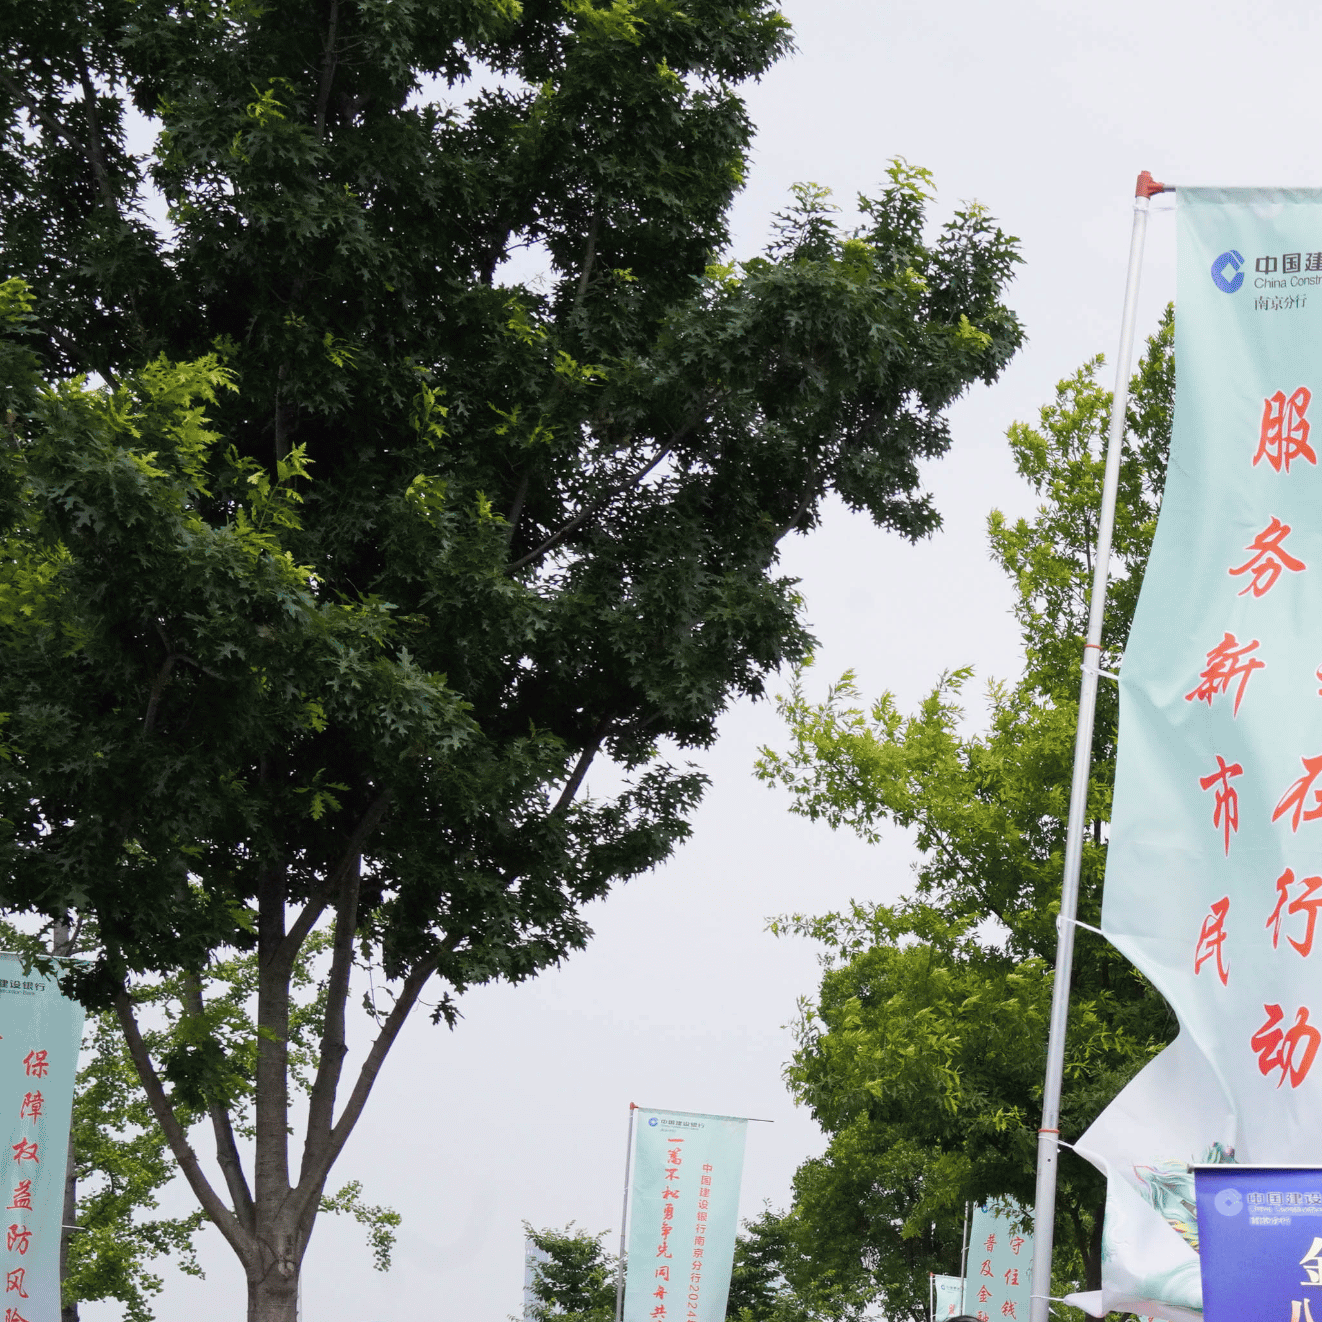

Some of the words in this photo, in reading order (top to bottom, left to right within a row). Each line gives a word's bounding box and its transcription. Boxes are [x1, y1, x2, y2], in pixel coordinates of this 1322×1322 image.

[1254, 277, 1287, 288] China
[1254, 294, 1307, 311] 南京分行
[1185, 386, 1318, 985] 服务新市民
